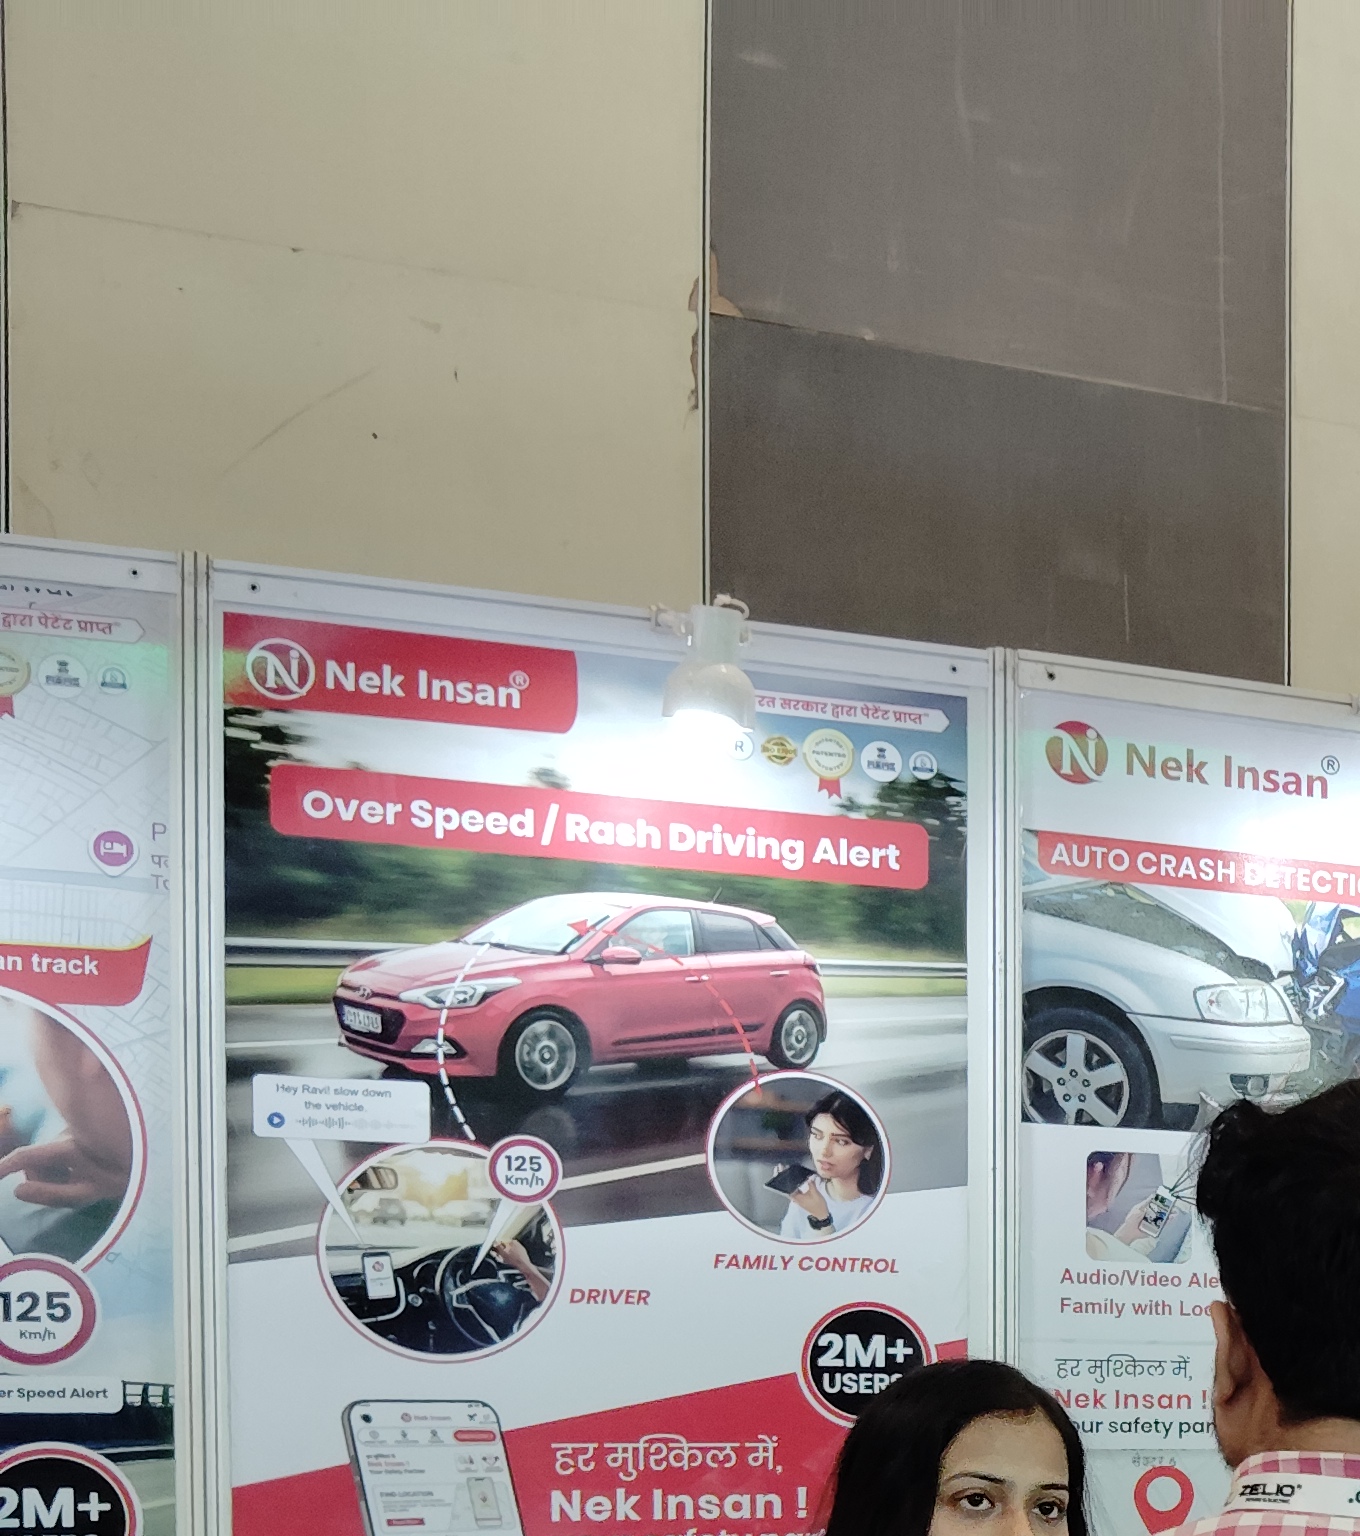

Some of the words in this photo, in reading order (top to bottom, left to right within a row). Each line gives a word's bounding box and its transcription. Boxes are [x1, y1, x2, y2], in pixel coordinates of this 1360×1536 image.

[325, 660, 405, 698] Nek
[1125, 742, 1208, 786] Nek
[302, 789, 402, 825] Over
[410, 799, 534, 841] Speed
[565, 812, 661, 850] Rash
[669, 820, 805, 871] Driving
[812, 837, 901, 871] Alert
[1050, 841, 1131, 873] AUTO
[1136, 850, 1236, 885] CRASH
[31, 953, 99, 976] track
[333, 1086, 359, 1097] slow
[361, 1088, 392, 1099] down
[304, 1101, 323, 1111] the
[504, 1154, 542, 1173] 125
[504, 1173, 545, 1188] Km/h
[713, 1252, 794, 1272] FAMILY
[798, 1255, 900, 1275] CONTROL
[1060, 1268, 1182, 1290] Audio/Video
[0, 1291, 71, 1323] 125
[569, 1287, 651, 1306] DRIVER
[1060, 1297, 1126, 1319] Family
[1131, 1299, 1173, 1318] with
[19, 1327, 56, 1342] Km/h
[816, 1332, 914, 1369] 2M+
[1055, 1358, 1083, 1378] हर
[1086, 1353, 1167, 1384] मुश्किल
[17, 1387, 66, 1402] Speed
[70, 1387, 109, 1399] Alert
[1054, 1388, 1107, 1410] Nek
[1115, 1389, 1192, 1410] Insan
[1108, 1416, 1174, 1439] safety
[551, 1442, 598, 1475] हर
[604, 1433, 740, 1481] मुश्किल
[0, 1487, 111, 1529] 2M+
[550, 1488, 642, 1523] Nek
[652, 1487, 783, 1521] Insan
